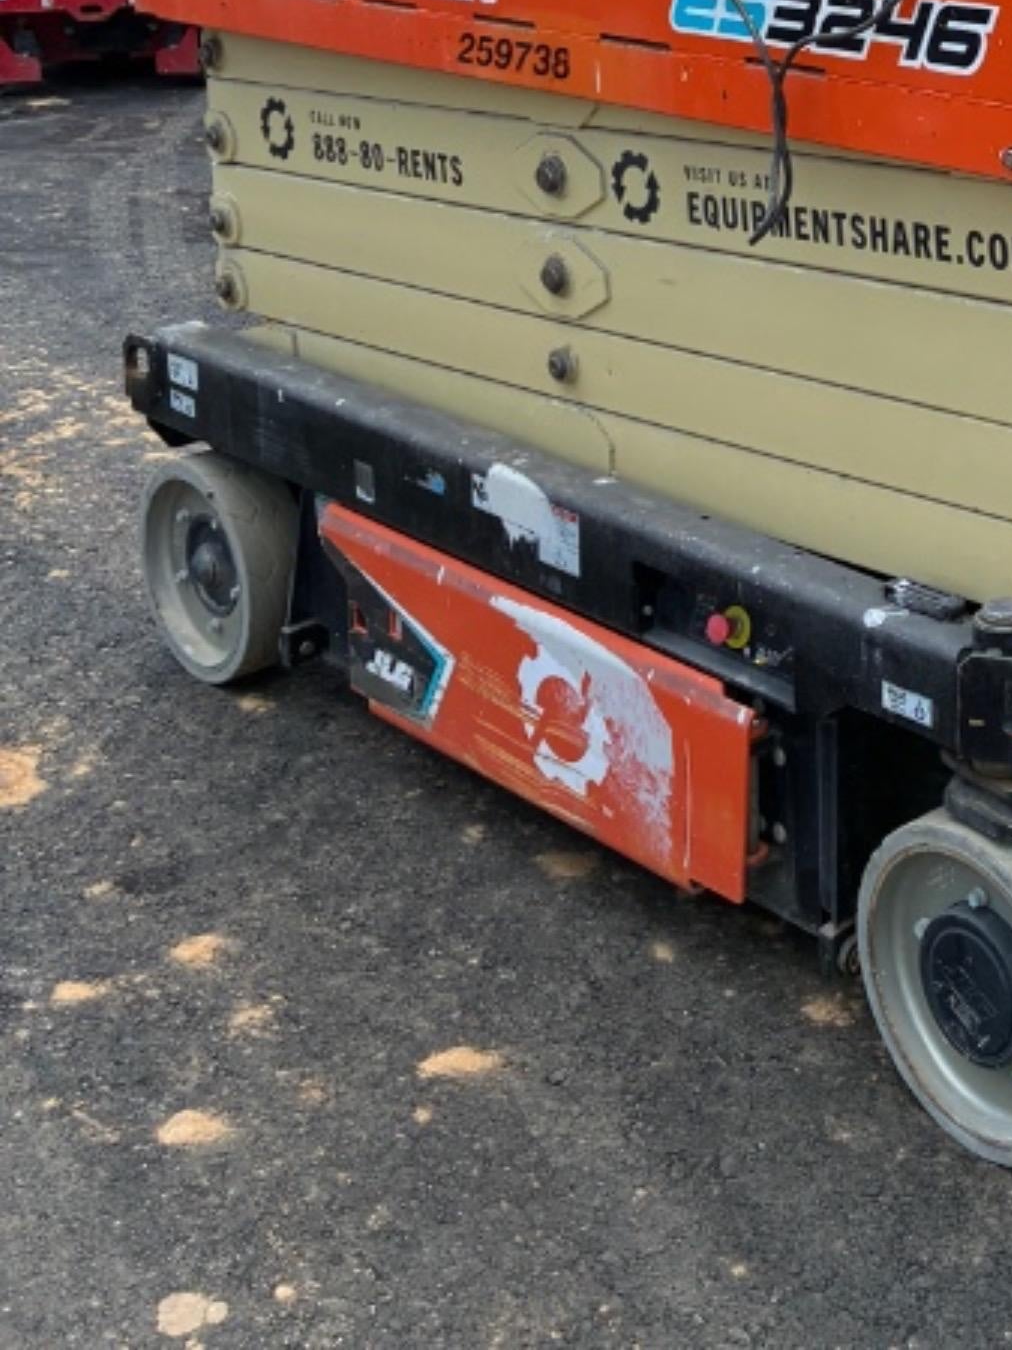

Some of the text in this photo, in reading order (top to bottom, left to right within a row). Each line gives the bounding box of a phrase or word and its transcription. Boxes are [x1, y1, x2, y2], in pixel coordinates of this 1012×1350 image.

[457, 32, 570, 79] 259738
[310, 110, 334, 127] CALL
[312, 132, 464, 187] 888-80-RENTS
[683, 164, 721, 184] VISIT
[729, 169, 747, 187] US
